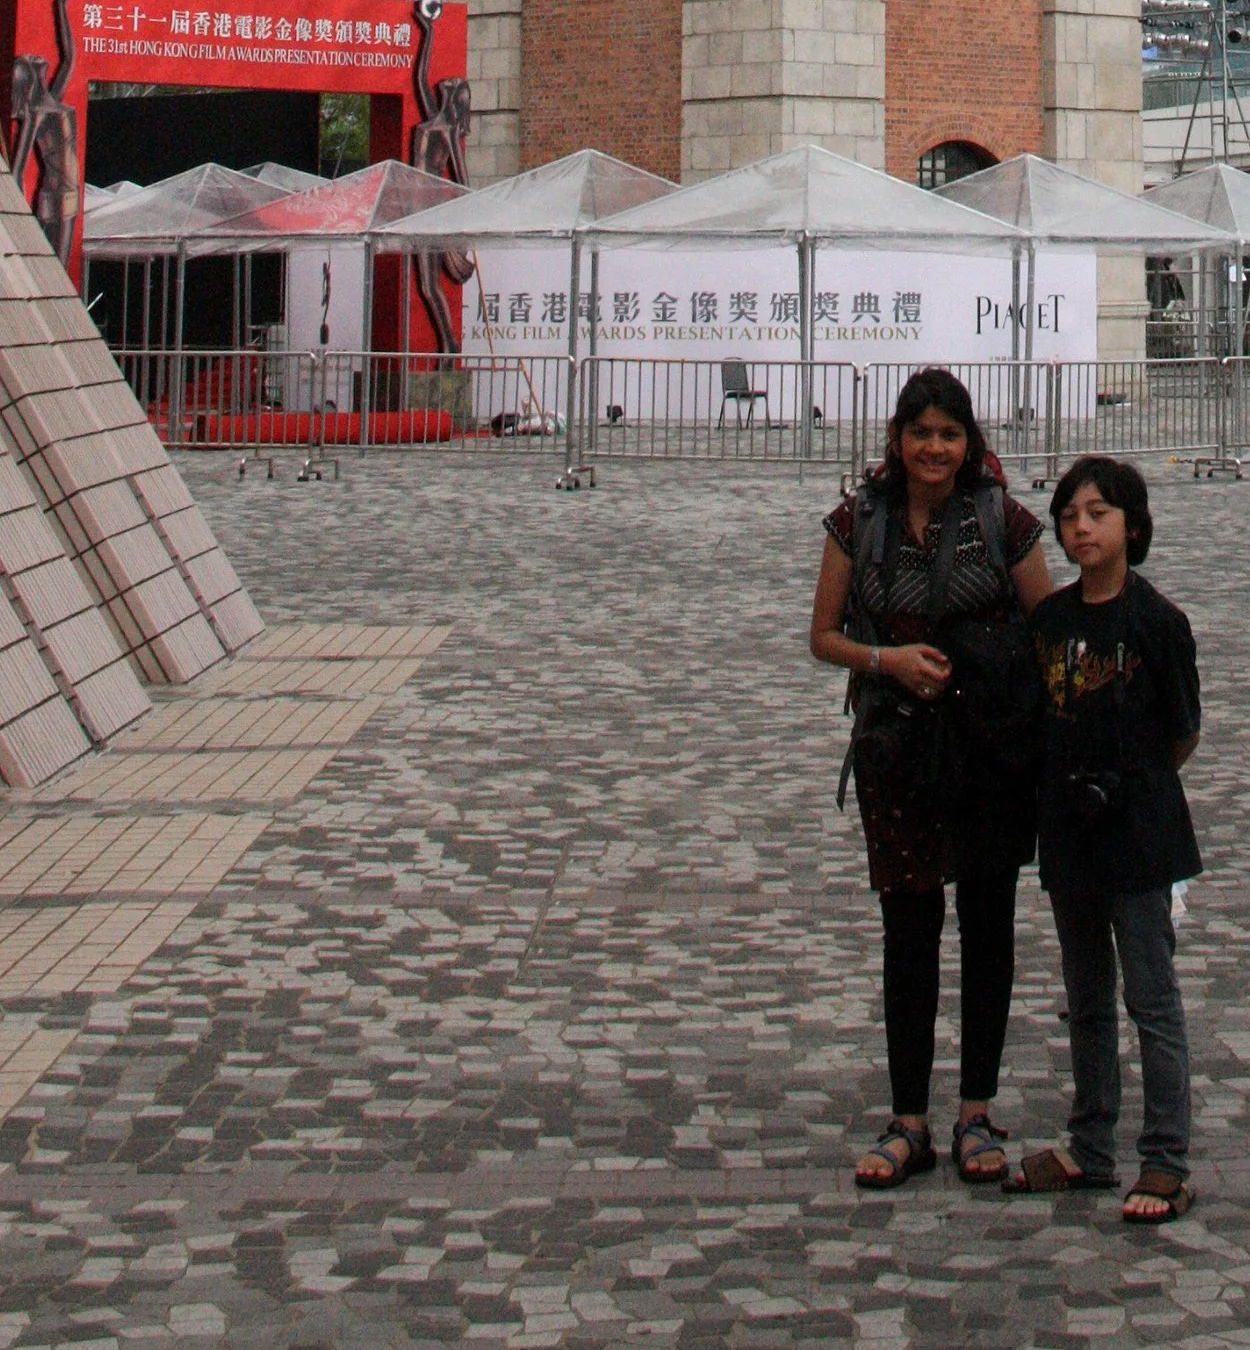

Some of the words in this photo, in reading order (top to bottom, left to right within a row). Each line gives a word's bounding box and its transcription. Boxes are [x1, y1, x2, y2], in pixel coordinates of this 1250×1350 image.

[83, 36, 106, 53] THE
[108, 38, 127, 54] 31st
[130, 40, 162, 56] HONG
[164, 41, 198, 59] KONG
[198, 43, 227, 60] FILM
[227, 45, 273, 63] AWARDS
[274, 48, 353, 66] PRESENTATION
[353, 51, 413, 69] CEREMONY
[471, 326, 517, 340] KONG
[523, 326, 561, 340] FILM
[653, 326, 803, 341] PRESENTATION
[811, 326, 924, 341] CEREMONY
